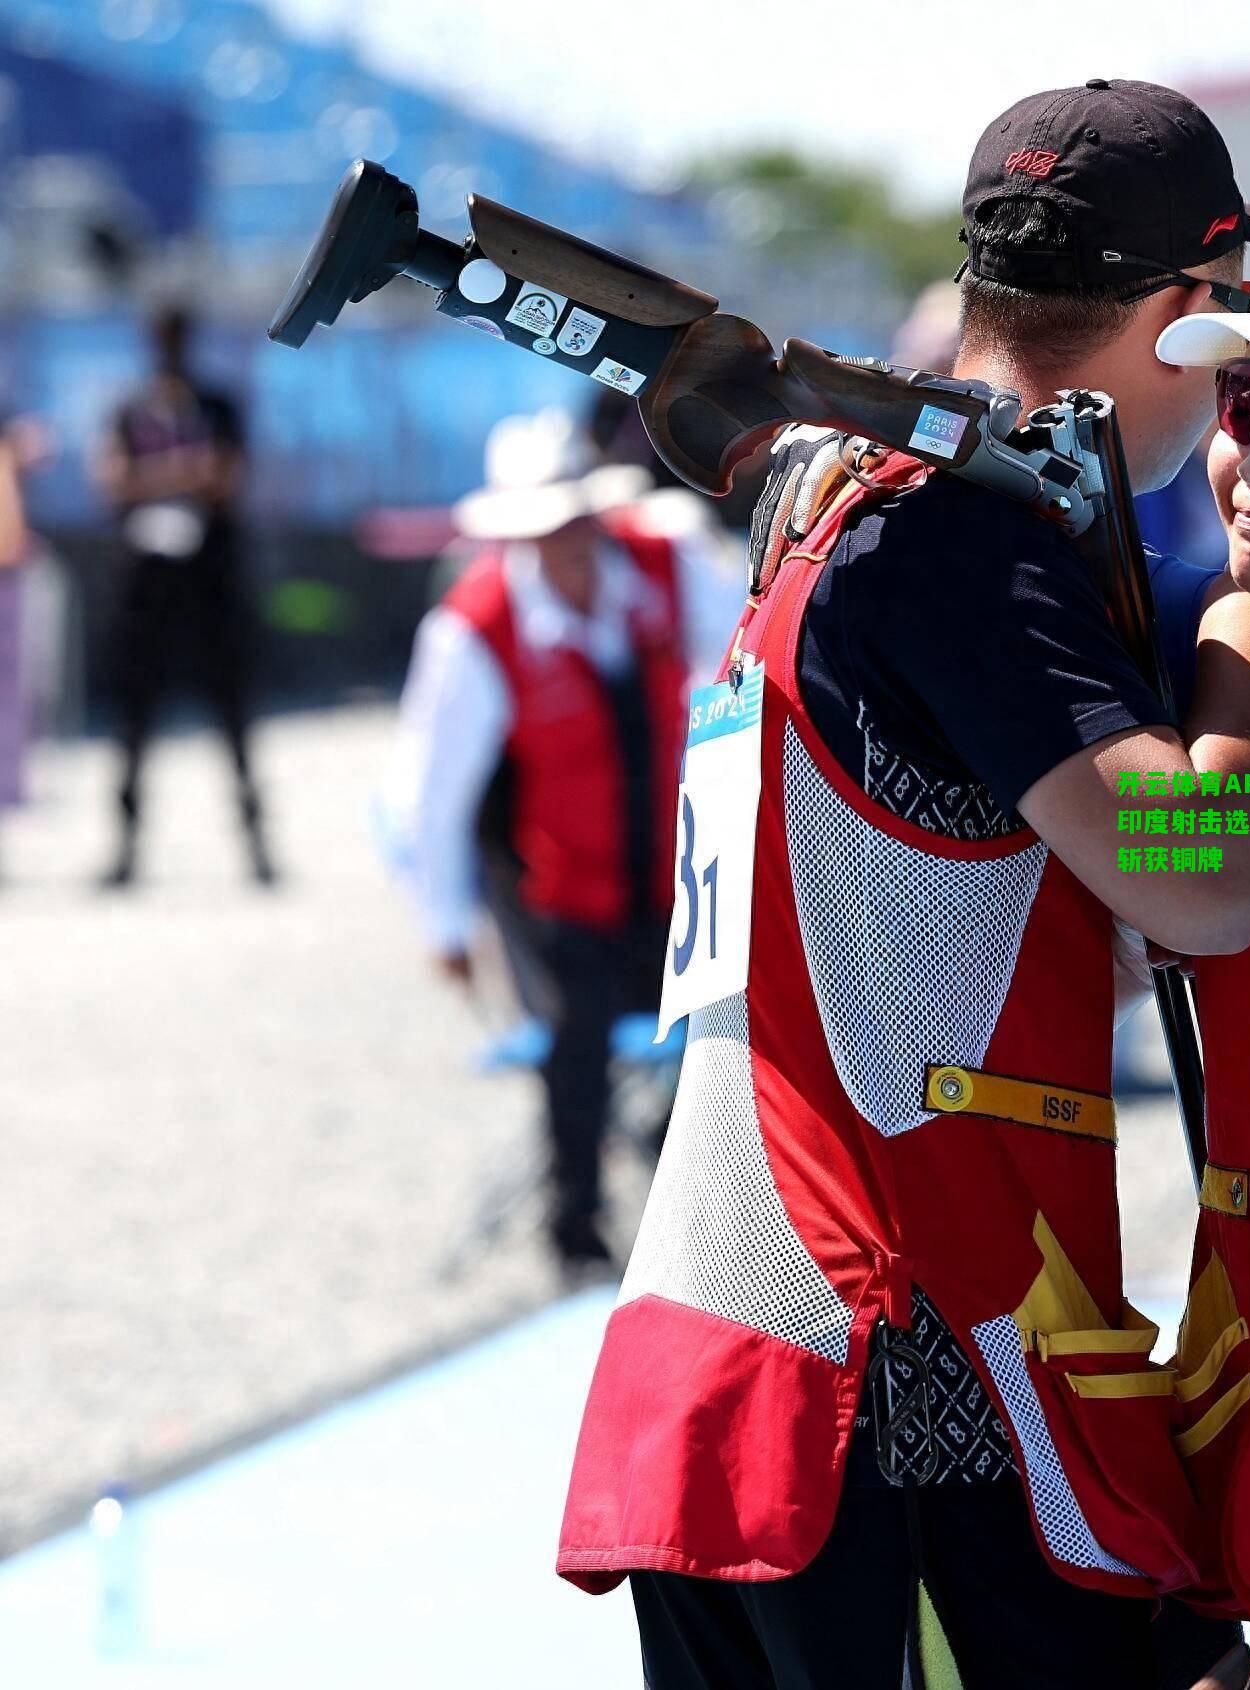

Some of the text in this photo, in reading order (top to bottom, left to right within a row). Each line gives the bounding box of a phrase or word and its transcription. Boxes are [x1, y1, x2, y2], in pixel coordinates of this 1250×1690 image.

[924, 422, 955, 438] 2024
[927, 413, 958, 430] PARIS
[1042, 1094, 1082, 1124] ISSF
